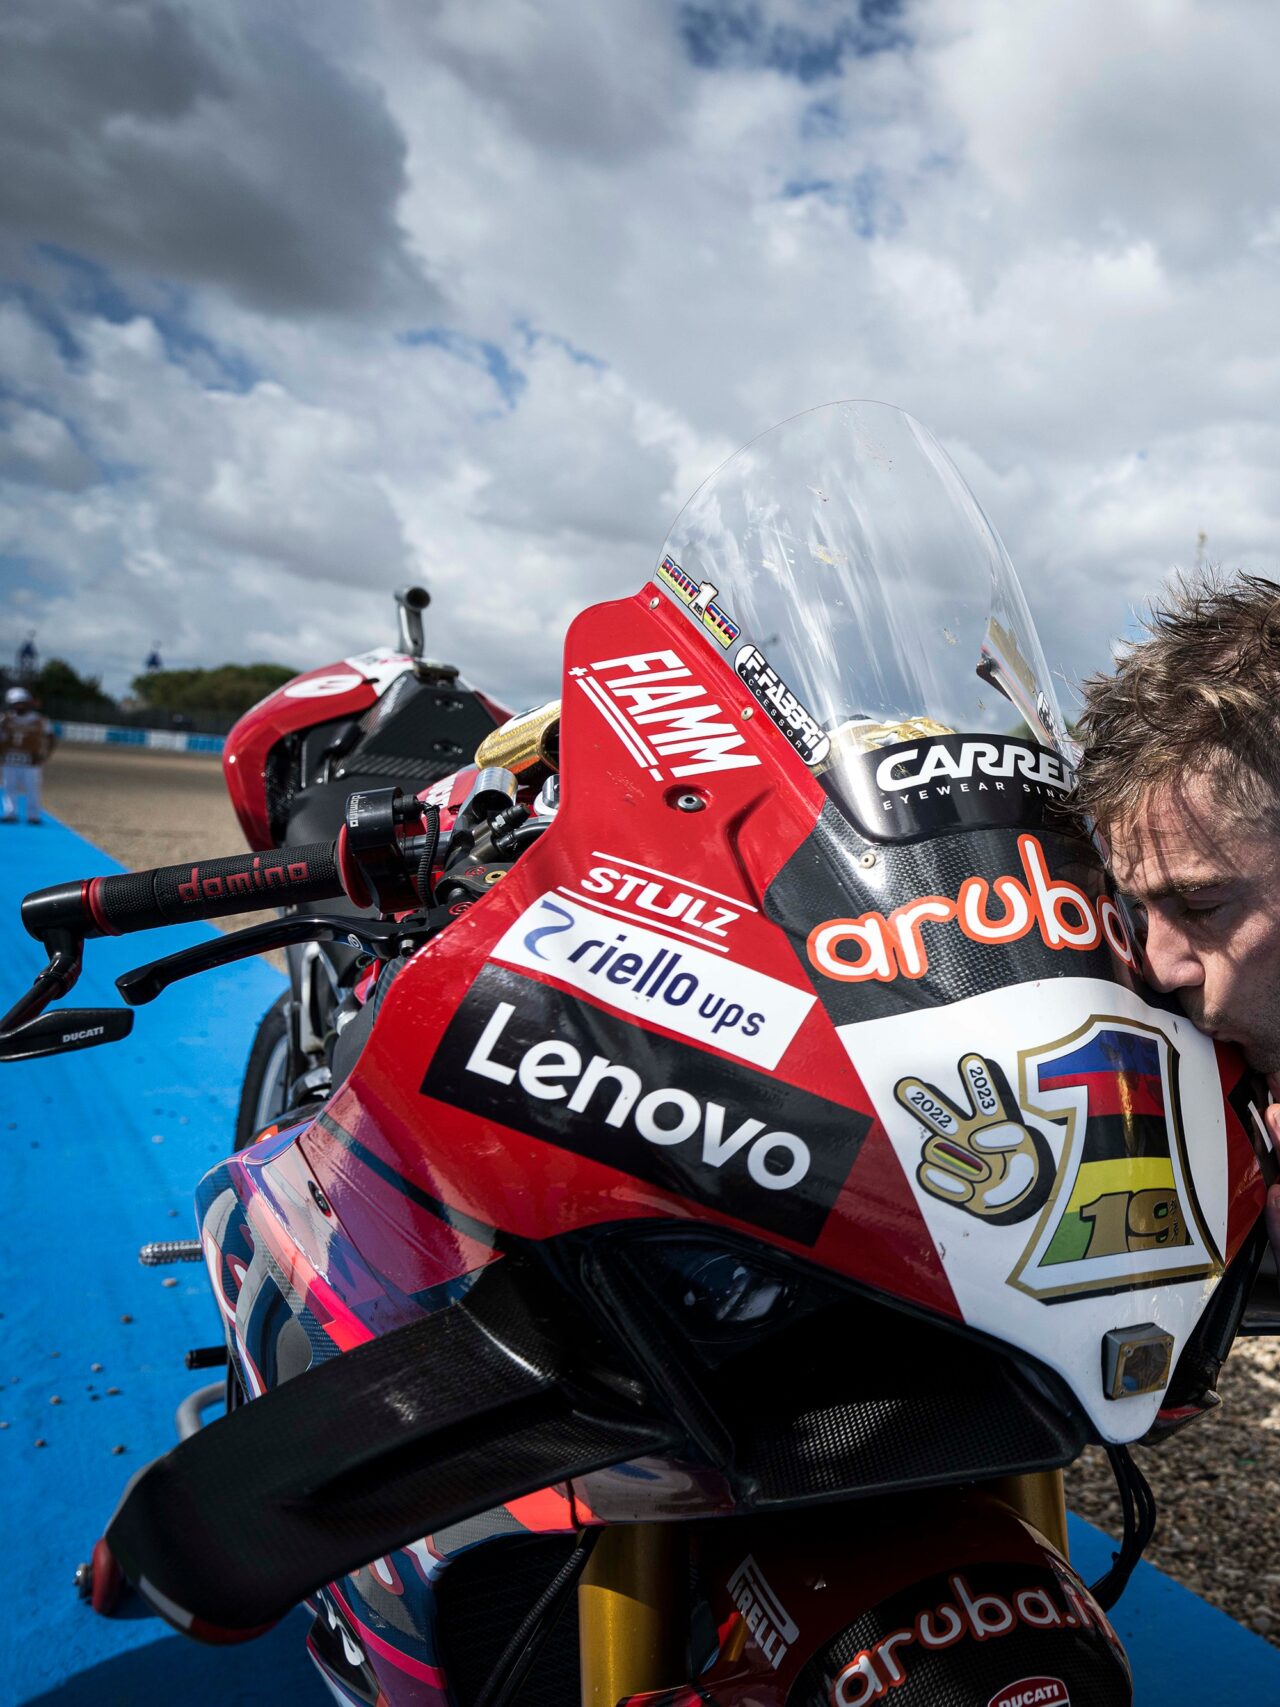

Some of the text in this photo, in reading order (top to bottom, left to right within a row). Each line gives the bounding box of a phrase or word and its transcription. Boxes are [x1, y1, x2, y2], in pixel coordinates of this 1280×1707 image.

[589, 649, 763, 778] FIAMM
[740, 669, 810, 757] ACCESSORI
[883, 782, 1006, 811] EYEWEAR
[178, 857, 309, 901] domino
[580, 867, 740, 937] STULZ
[567, 934, 766, 1036] riello ups
[62, 1026, 104, 1043] DUCATI
[465, 1002, 811, 1190] Lenovo
[910, 1091, 953, 1129] 2022
[969, 1066, 996, 1110] 2023
[1080, 1188, 1187, 1259] 19
[726, 1553, 800, 1670] PIRELLI
